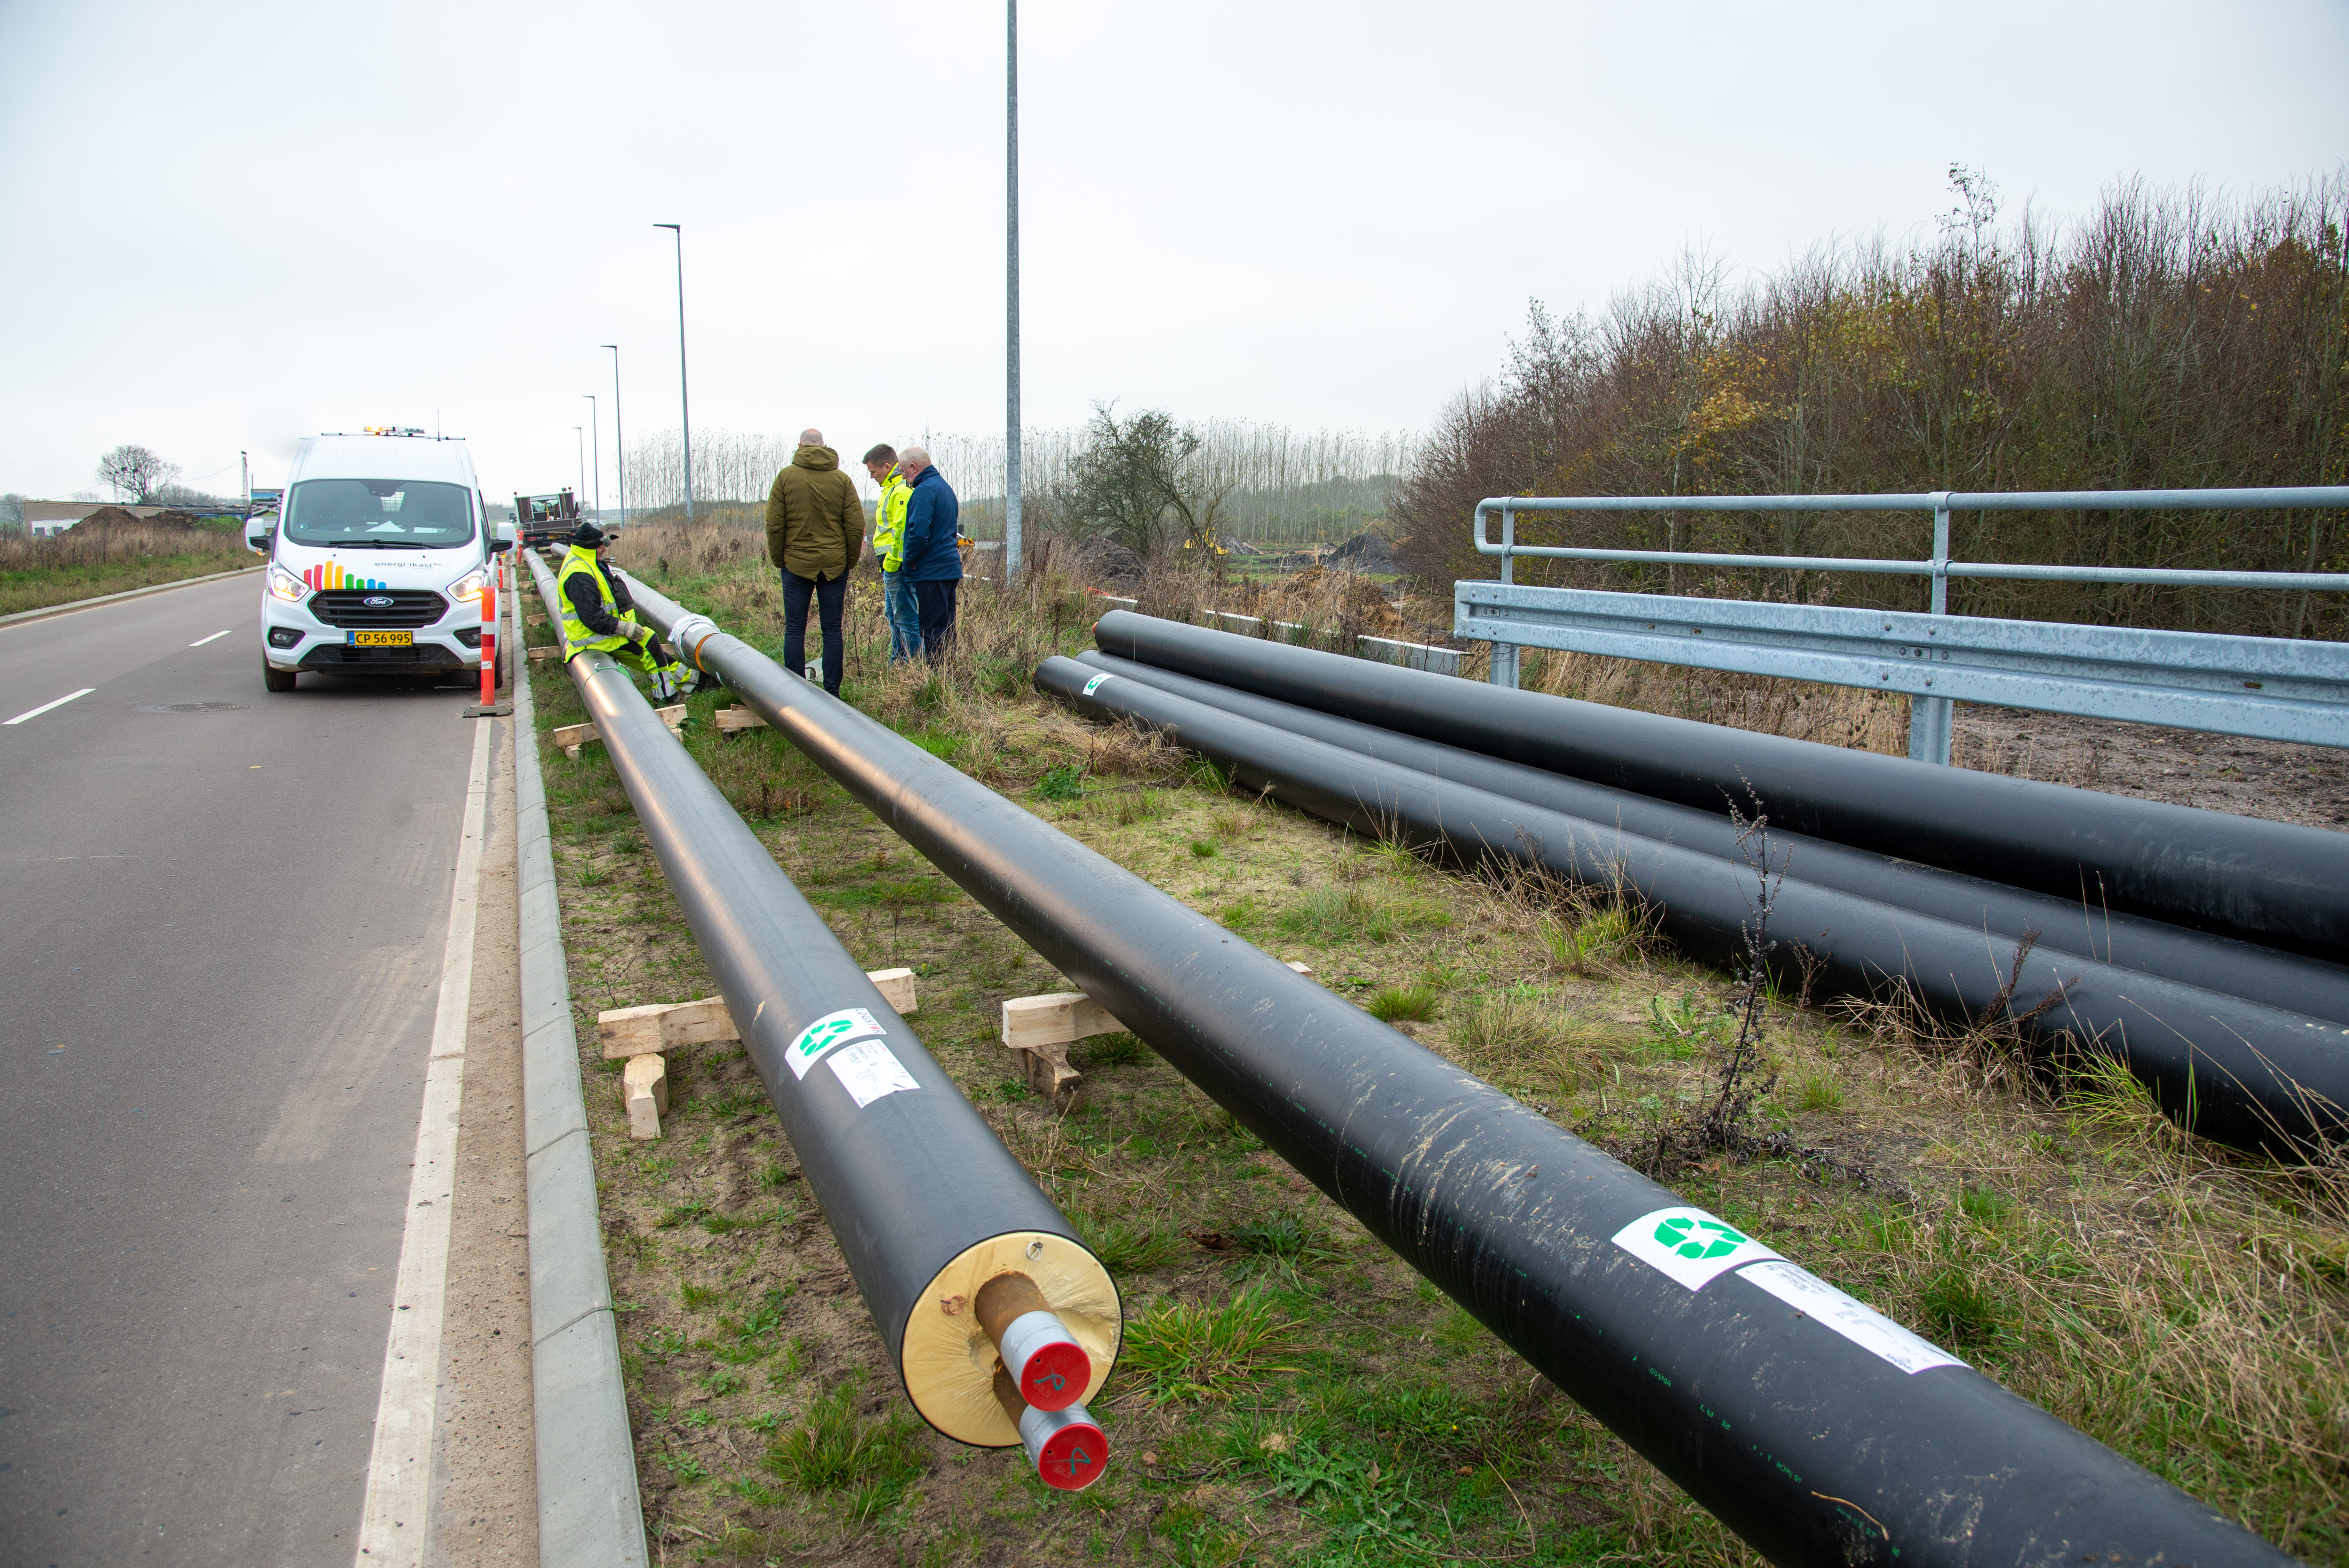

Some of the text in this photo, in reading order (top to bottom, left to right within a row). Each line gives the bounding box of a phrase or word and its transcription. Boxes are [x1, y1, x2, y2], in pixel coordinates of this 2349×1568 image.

[356, 634, 410, 644] CP 56 995
